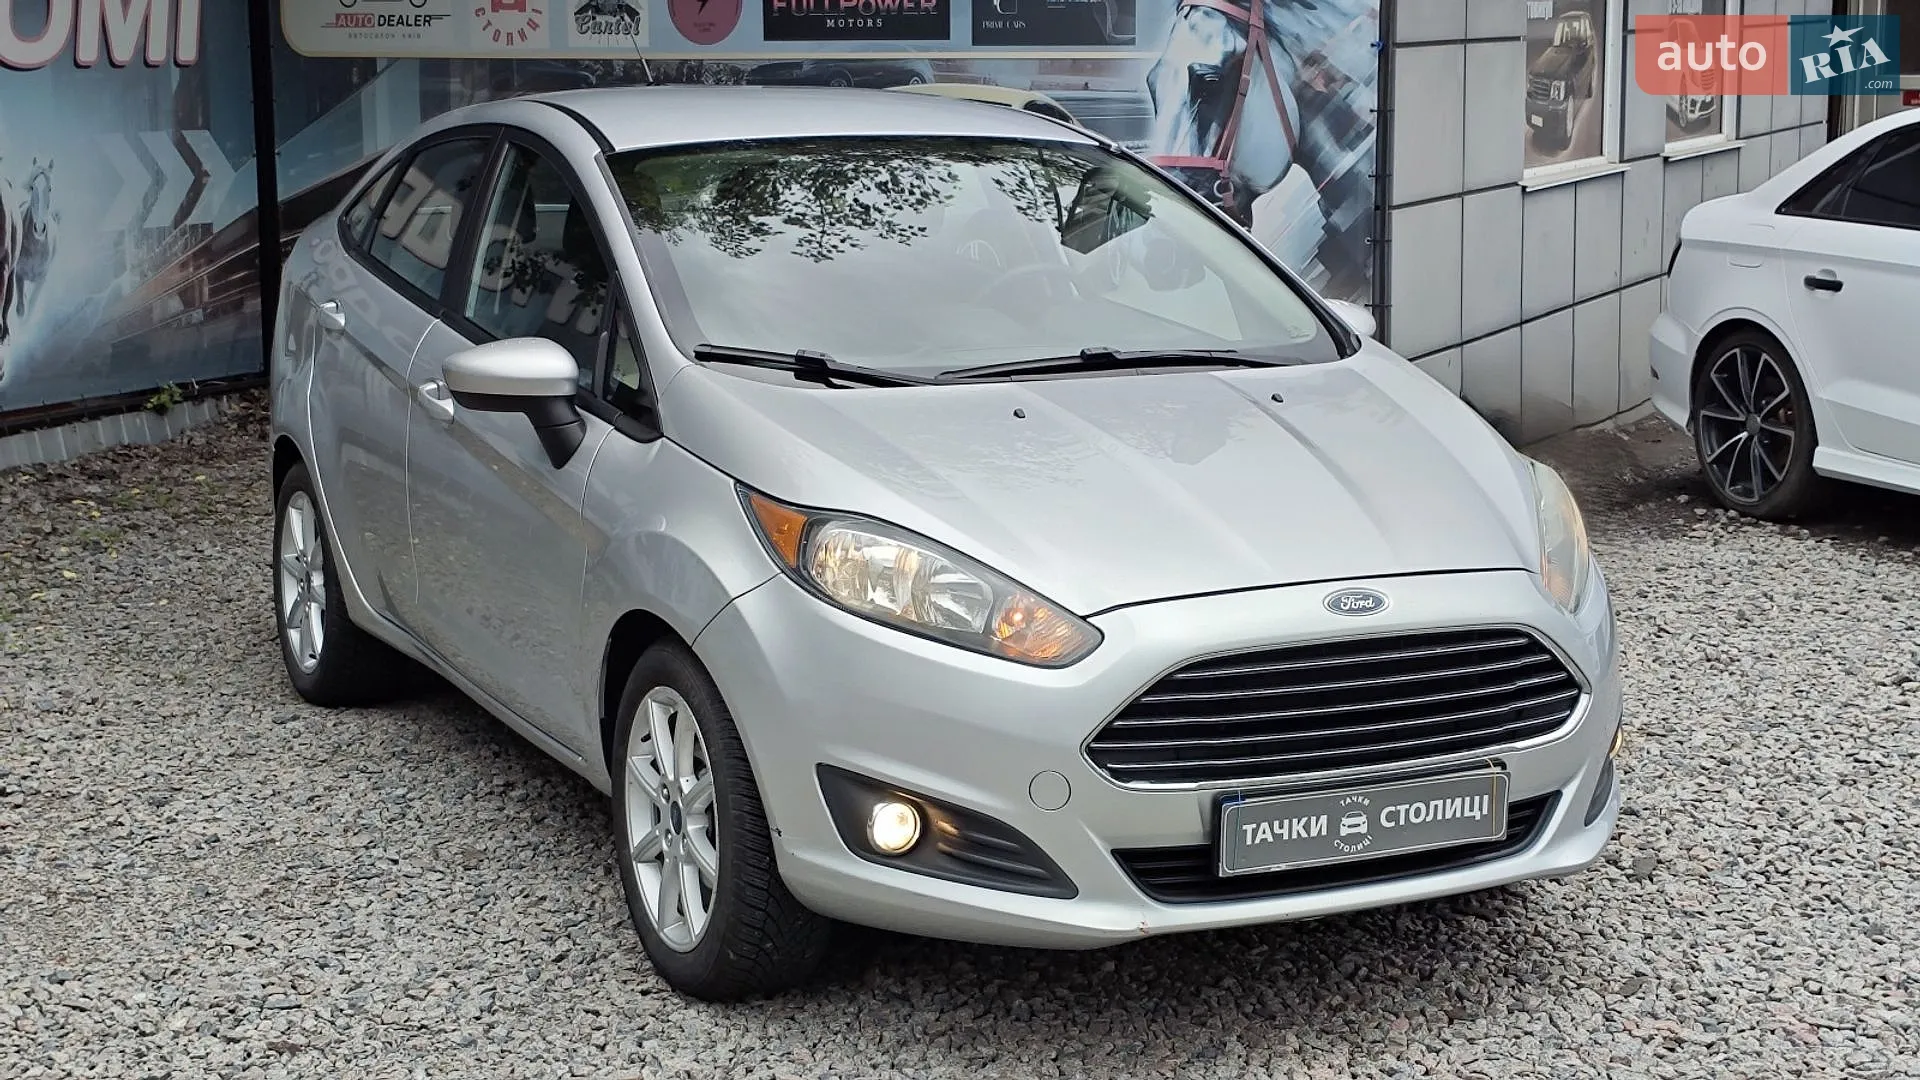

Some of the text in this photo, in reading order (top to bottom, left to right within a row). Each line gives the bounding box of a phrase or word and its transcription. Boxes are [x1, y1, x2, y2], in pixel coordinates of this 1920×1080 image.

[337, 14, 432, 27] AUTO DEALER
[826, 19, 883, 28] MOTORS
[1340, 595, 1375, 610] Ford
[1340, 795, 1371, 807] ТАЧКИ
[1242, 794, 1489, 846] ТАЧКИ СТОЛИЦІ
[1334, 835, 1373, 853] СТОЛИЦІ
